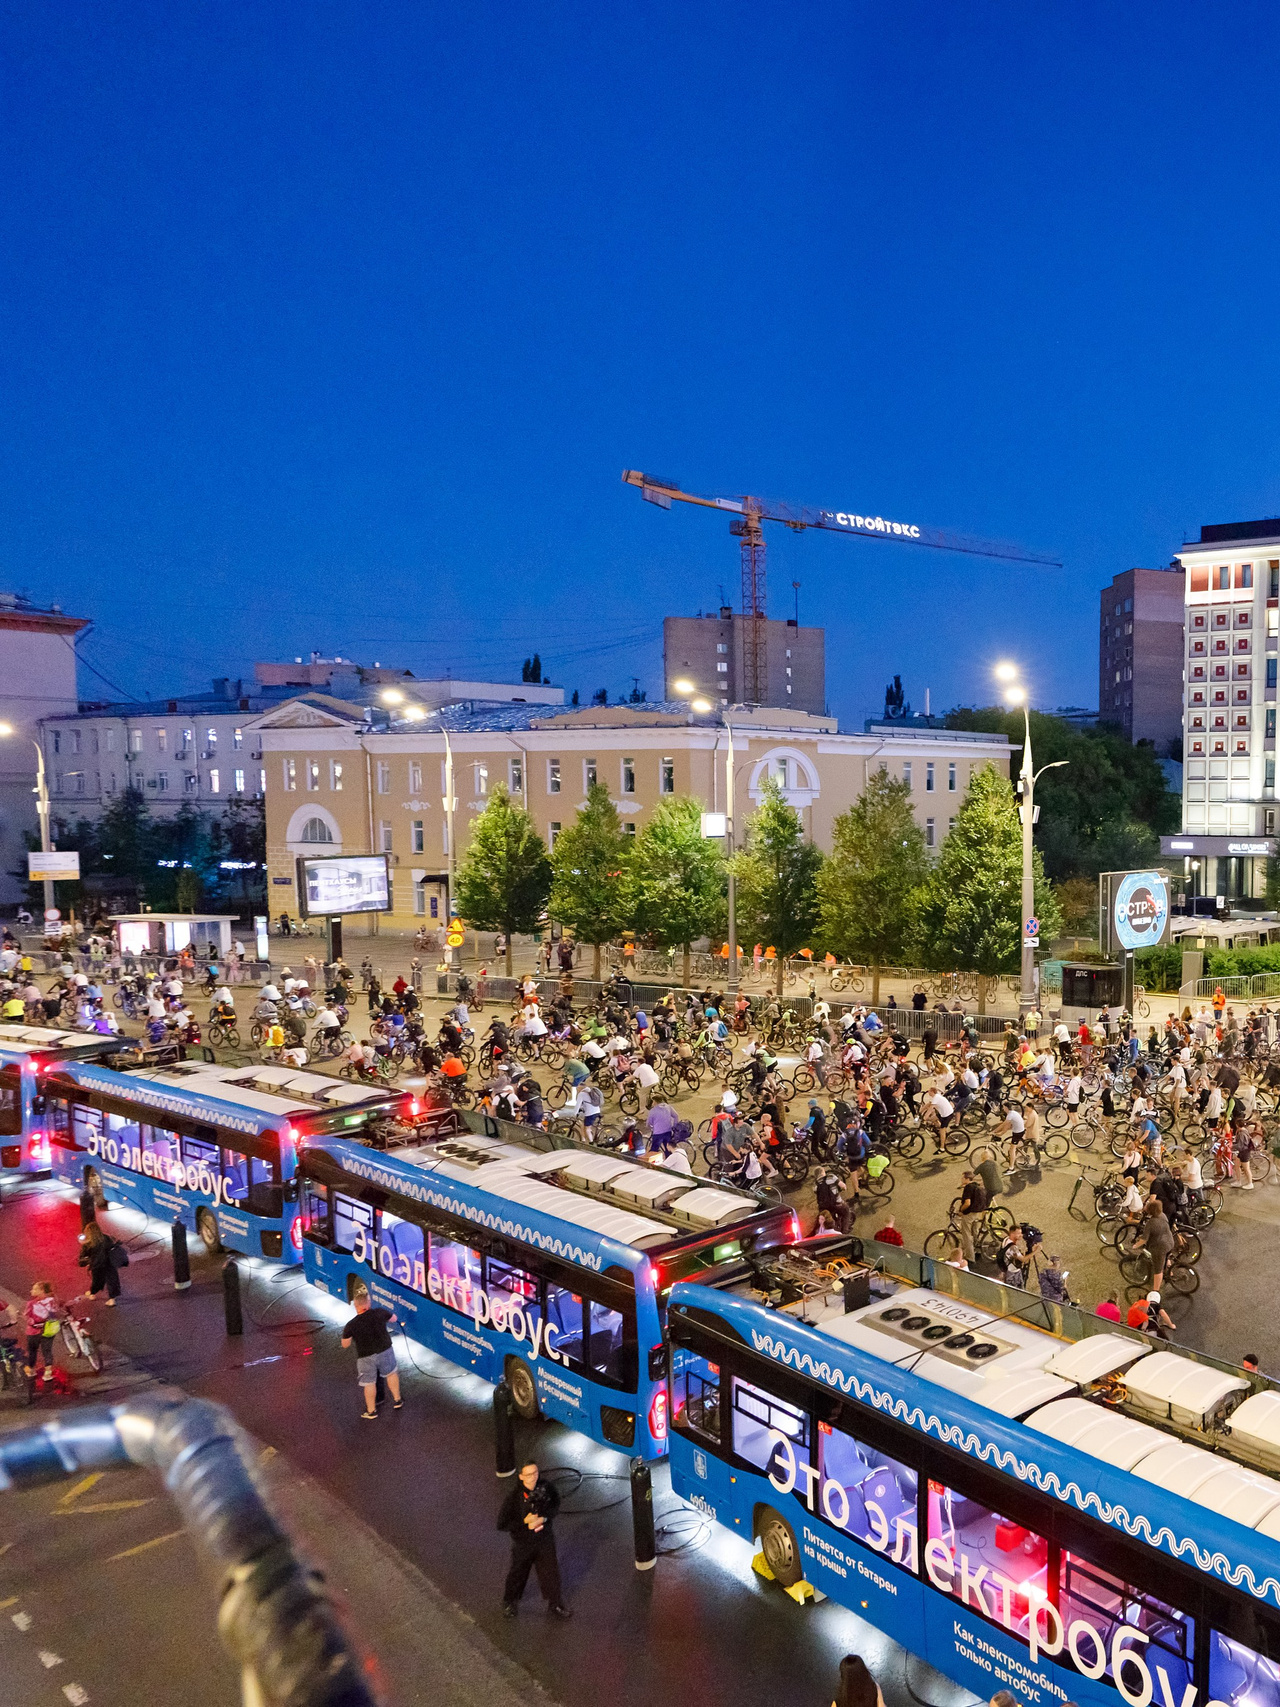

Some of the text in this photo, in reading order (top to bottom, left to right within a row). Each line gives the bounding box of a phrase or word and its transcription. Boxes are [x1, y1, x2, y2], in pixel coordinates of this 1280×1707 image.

[86, 1123, 118, 1163] Это
[351, 1220, 570, 1367] Это электробус.
[921, 1298, 980, 1324] 490143
[768, 1429, 1231, 1707] Это электробу
[803, 1525, 897, 1596] Питается от батареи
[804, 1544, 847, 1578] на крыше
[953, 1620, 975, 1646] Как
[954, 1641, 1041, 1703] только автобус
